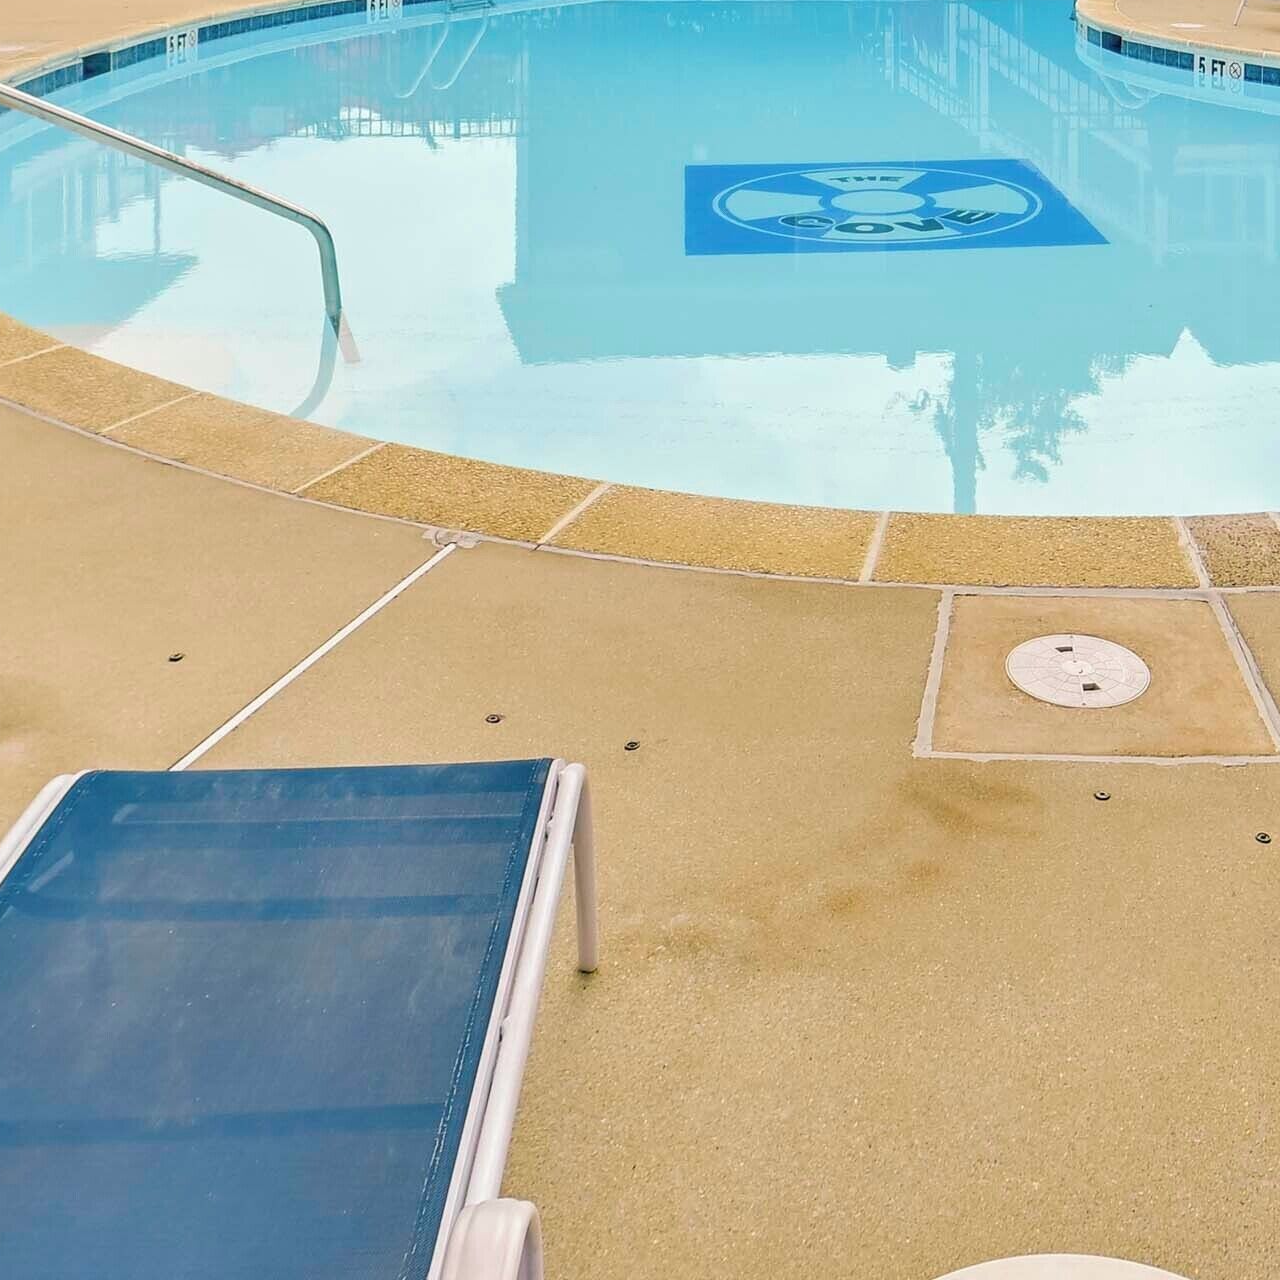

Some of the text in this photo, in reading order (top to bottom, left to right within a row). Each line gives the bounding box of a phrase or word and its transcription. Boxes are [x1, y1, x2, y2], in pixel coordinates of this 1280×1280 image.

[177, 32, 187, 49] FT
[1198, 57, 1226, 77] 5 FT
[827, 175, 907, 185] THE
[777, 208, 999, 236] COVE
